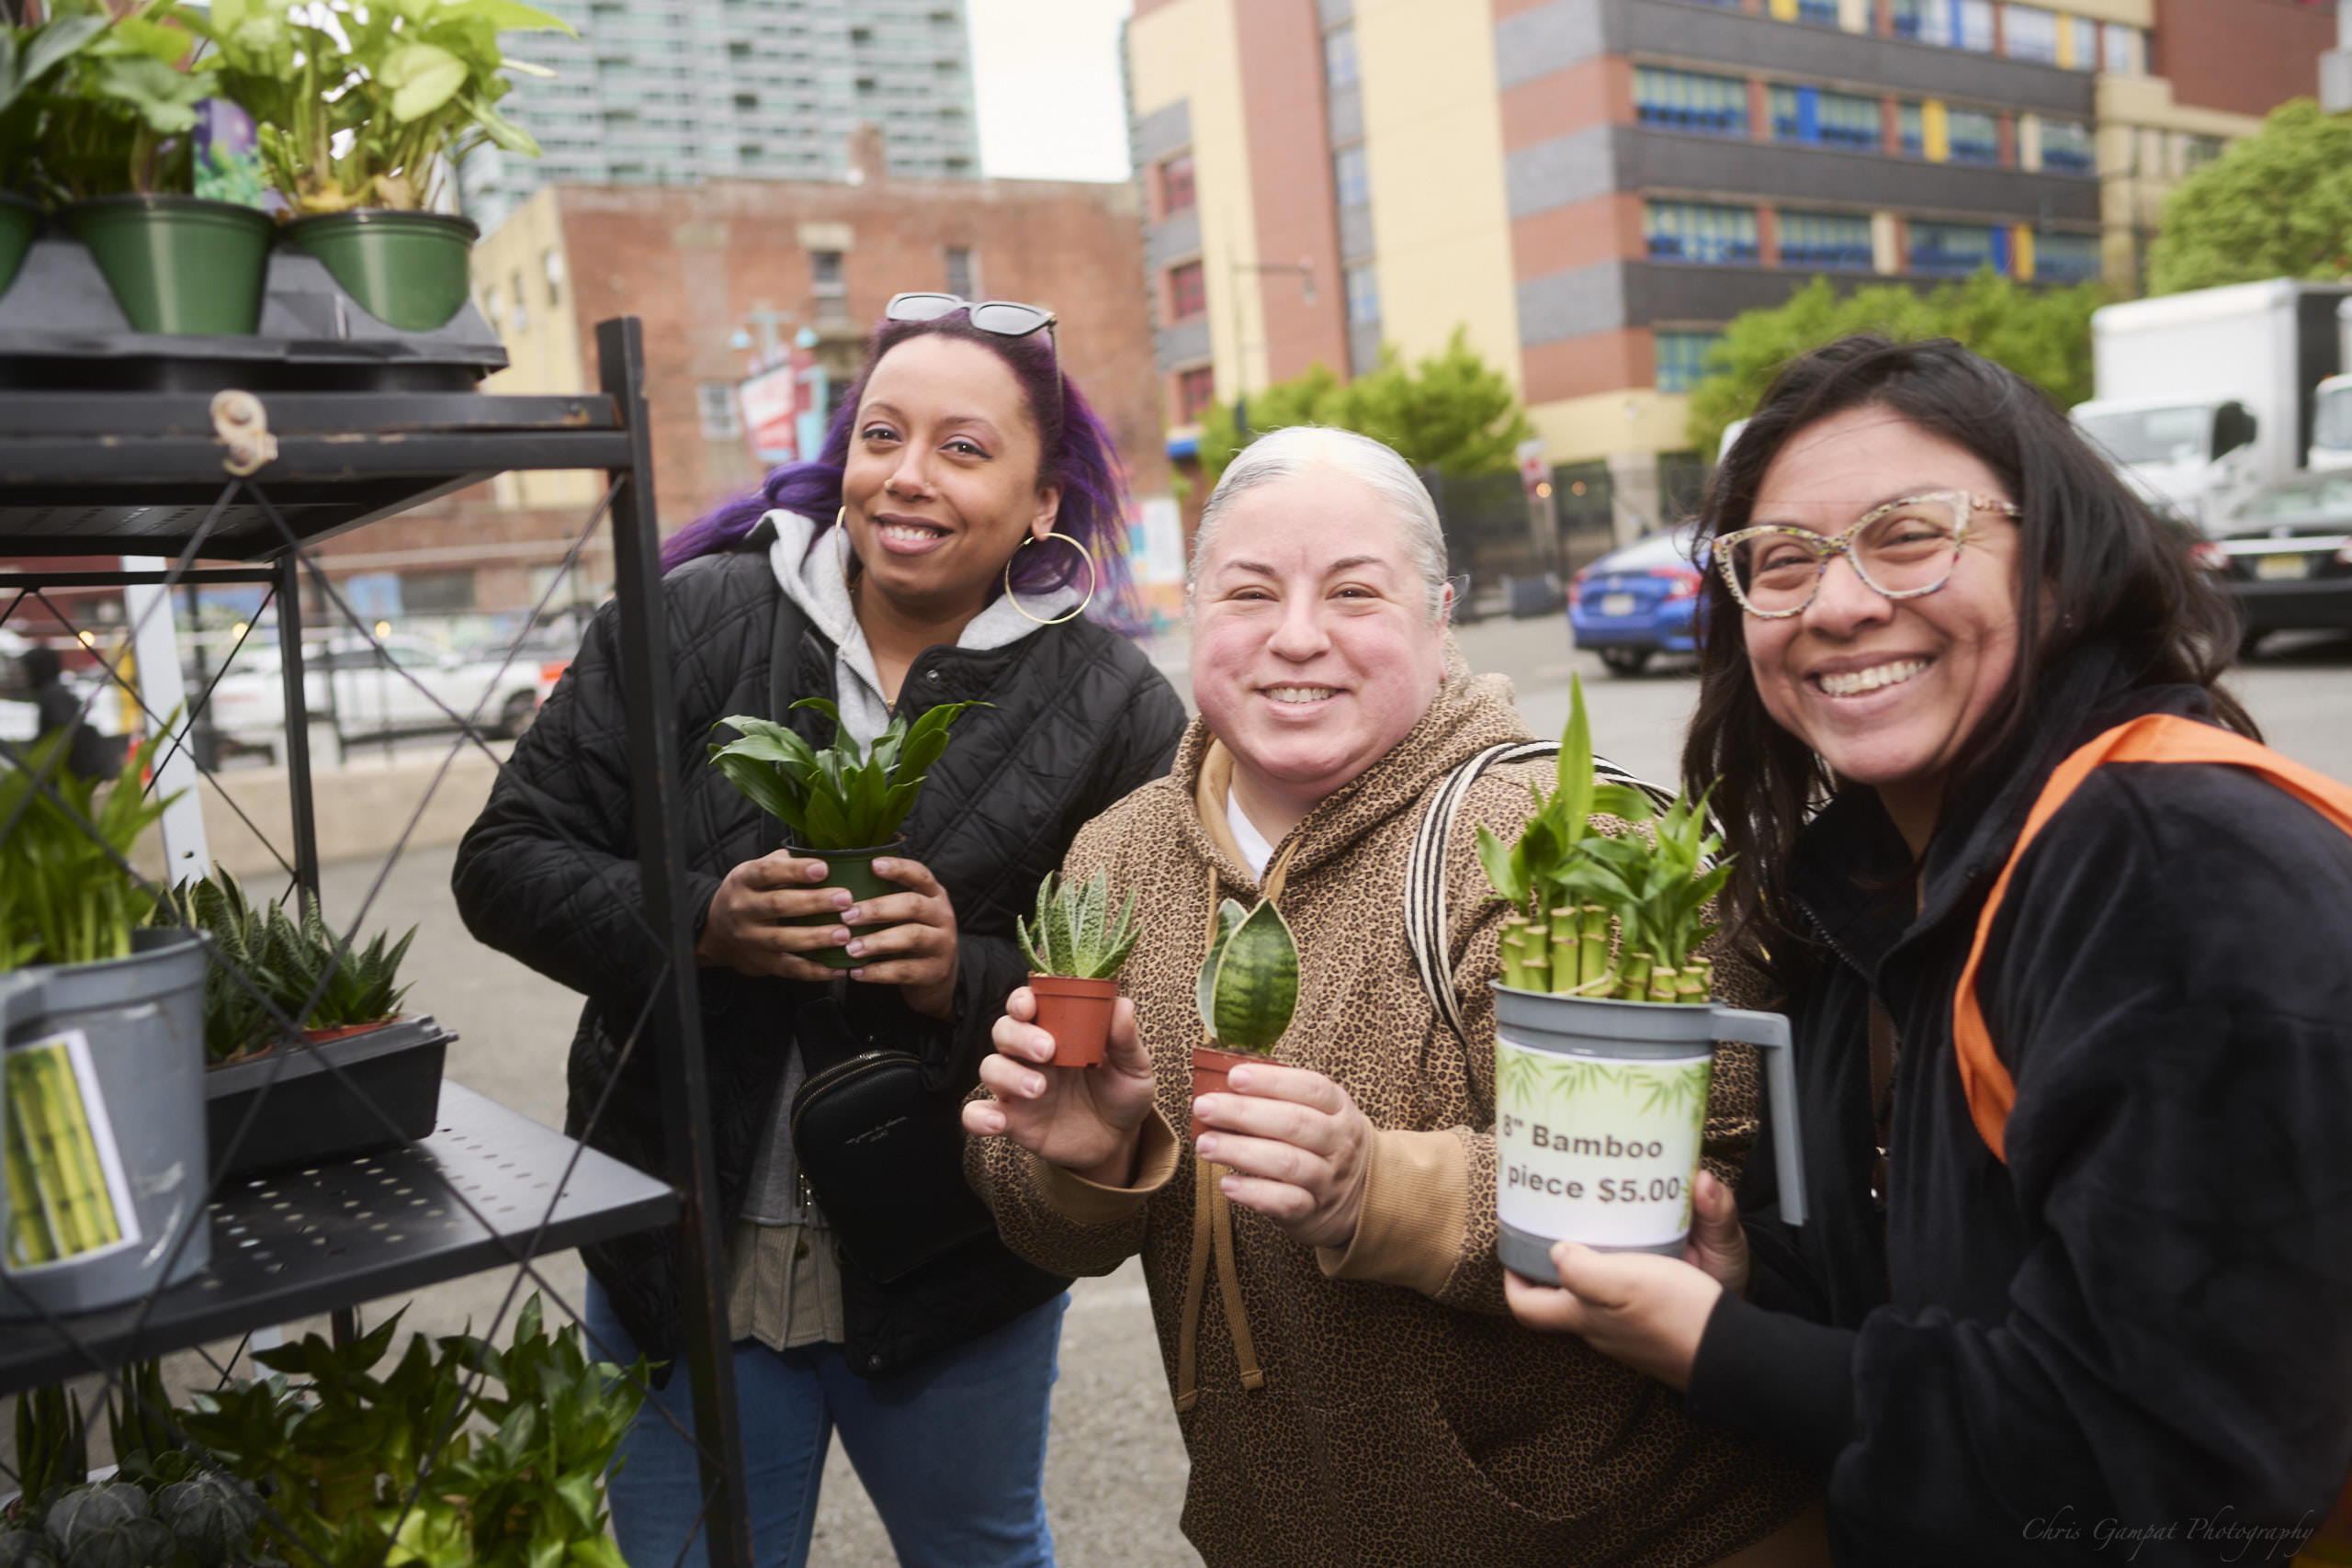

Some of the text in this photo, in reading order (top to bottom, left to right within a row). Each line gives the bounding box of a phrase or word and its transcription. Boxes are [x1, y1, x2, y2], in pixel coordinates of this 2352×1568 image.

[1532, 1124, 1664, 1158] Bamboo
[1508, 1164, 1585, 1198] piece
[1598, 1177, 1680, 1203] $5.00
